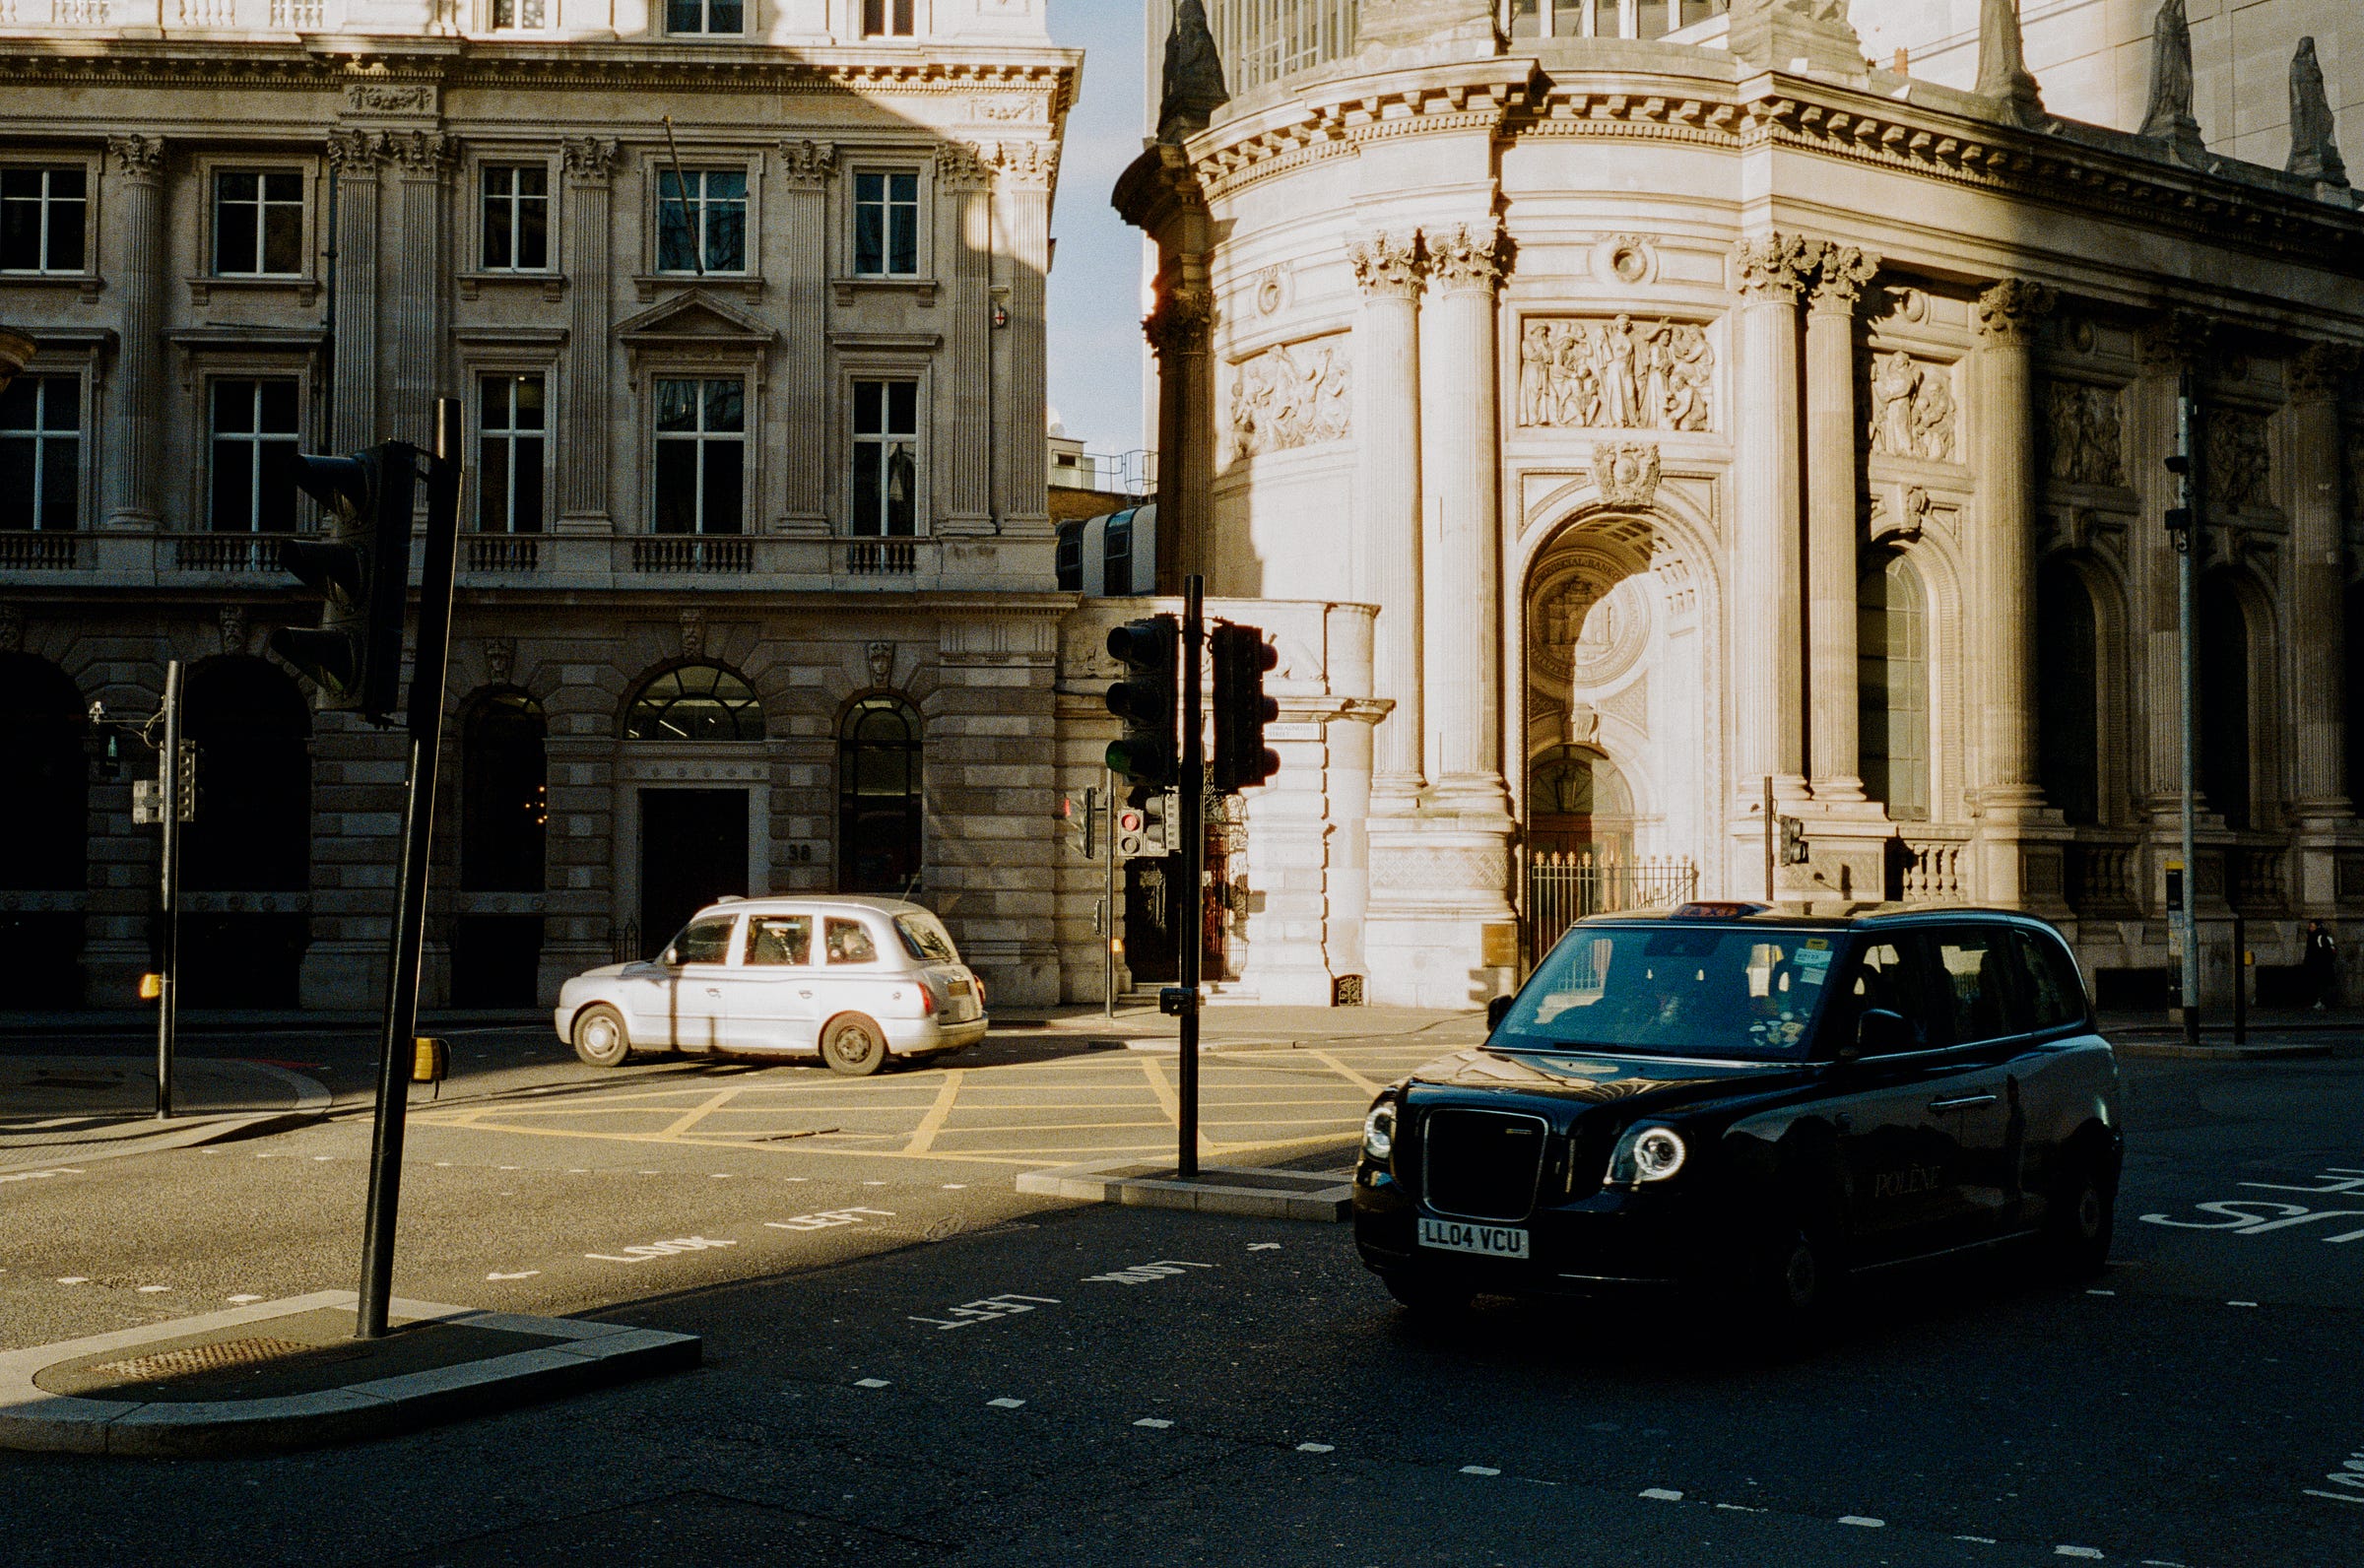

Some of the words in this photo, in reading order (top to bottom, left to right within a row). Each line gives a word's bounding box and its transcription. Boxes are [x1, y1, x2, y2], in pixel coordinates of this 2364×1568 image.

[585, 1236, 737, 1263] LOOK
[764, 1207, 895, 1230] LEFT
[1425, 1221, 1474, 1248] LL04
[1479, 1227, 1521, 1253] VCU
[907, 1293, 1062, 1330] LEFT
